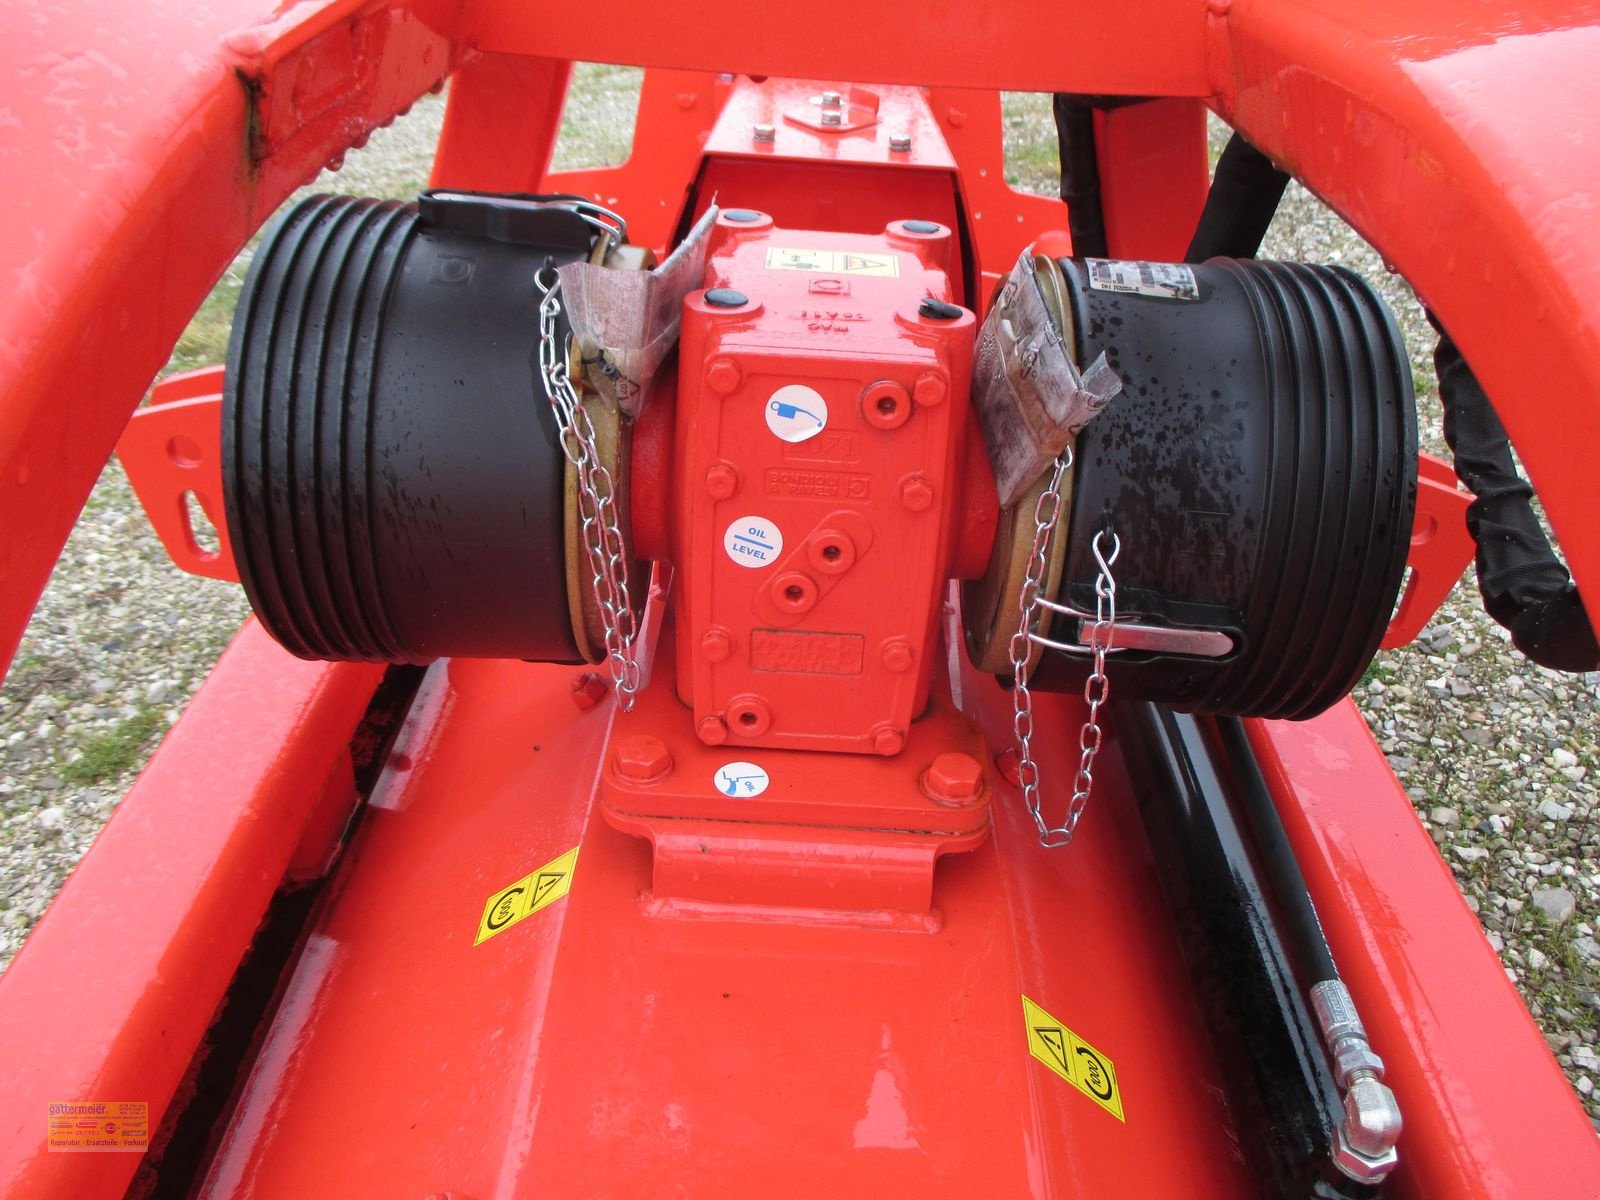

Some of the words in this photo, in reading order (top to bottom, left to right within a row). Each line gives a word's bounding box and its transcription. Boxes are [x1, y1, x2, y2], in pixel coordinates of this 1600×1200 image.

[769, 471, 839, 486] BONDIOLI
[789, 483, 839, 498] PAVESI
[748, 527, 767, 539] OIL
[732, 543, 767, 560] LEVEL
[744, 781, 755, 792] OIL
[1087, 1060, 1102, 1088] 1000
